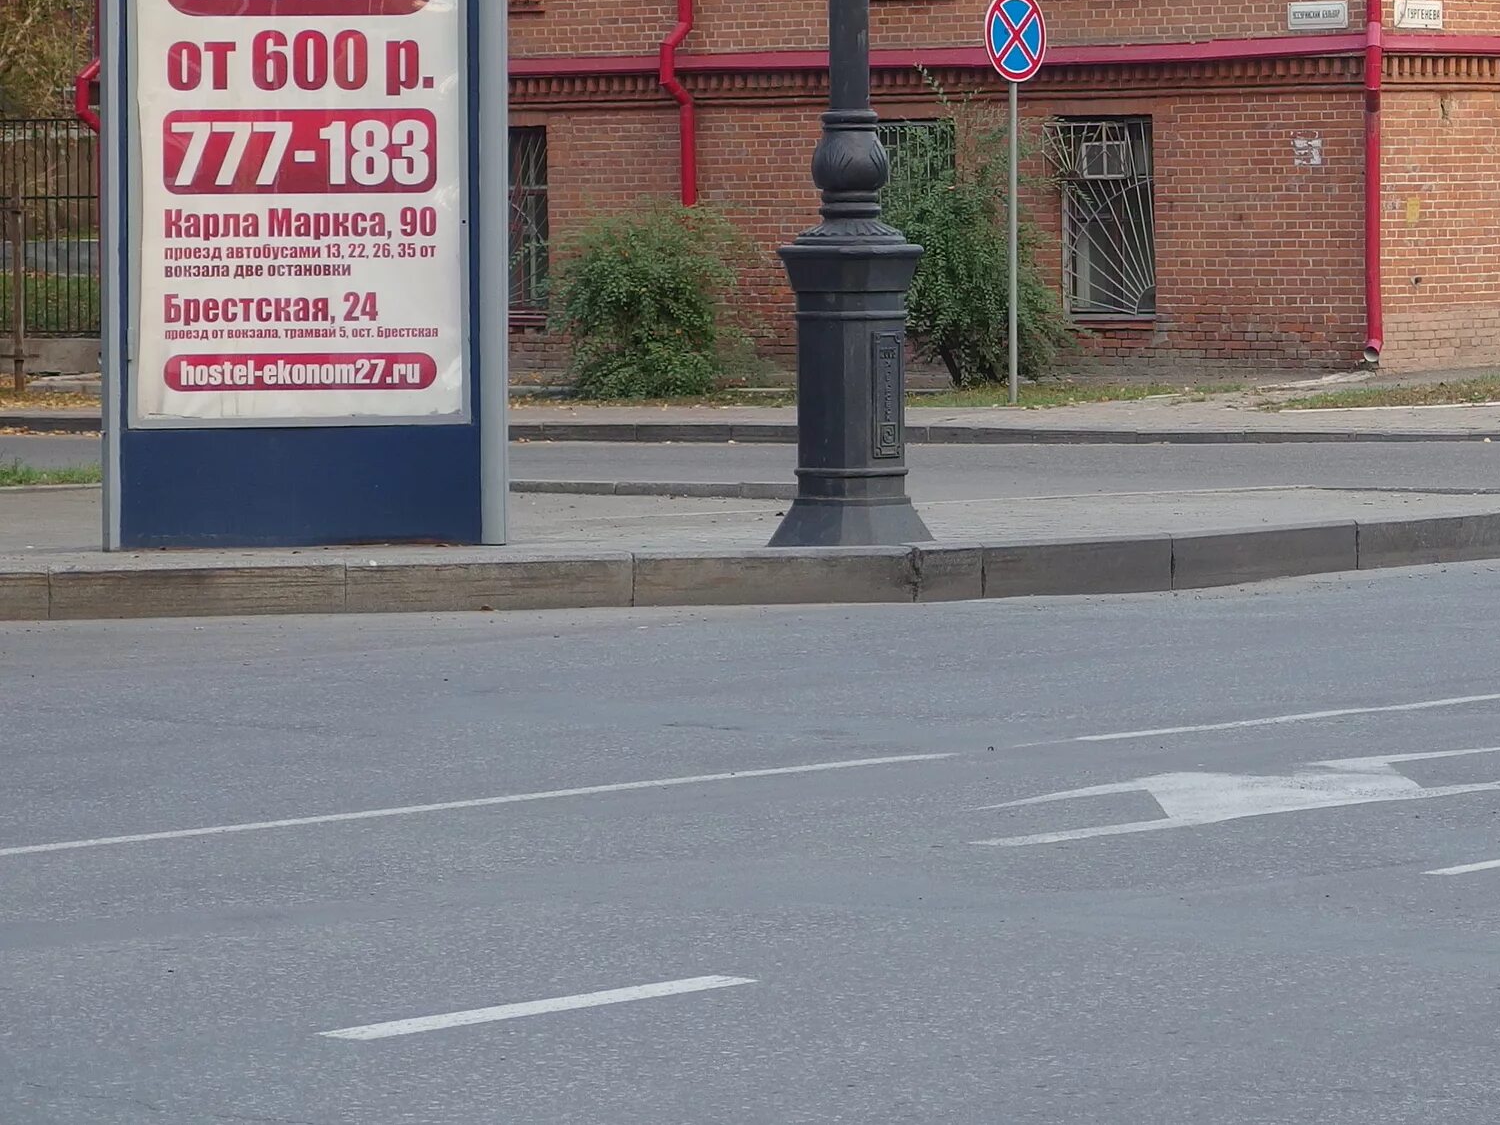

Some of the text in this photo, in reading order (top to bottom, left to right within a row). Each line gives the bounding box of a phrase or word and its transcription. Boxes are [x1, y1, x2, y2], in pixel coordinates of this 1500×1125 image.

[168, 29, 434, 96] от 600 р.
[171, 119, 430, 187] 777-183
[164, 206, 437, 241] Карла Маркса, 90
[164, 242, 436, 262] проезд автобусами 13, 22, 26, 35 от
[164, 263, 351, 280] вокзала две остановки
[164, 291, 378, 326] Брестская, 24
[164, 329, 209, 341] проезд
[211, 329, 225, 340] от
[284, 325, 337, 340] трамвай
[351, 328, 374, 339] ост.
[376, 326, 439, 339] Брестская
[180, 358, 421, 386] hostel-ekonom27.ru
